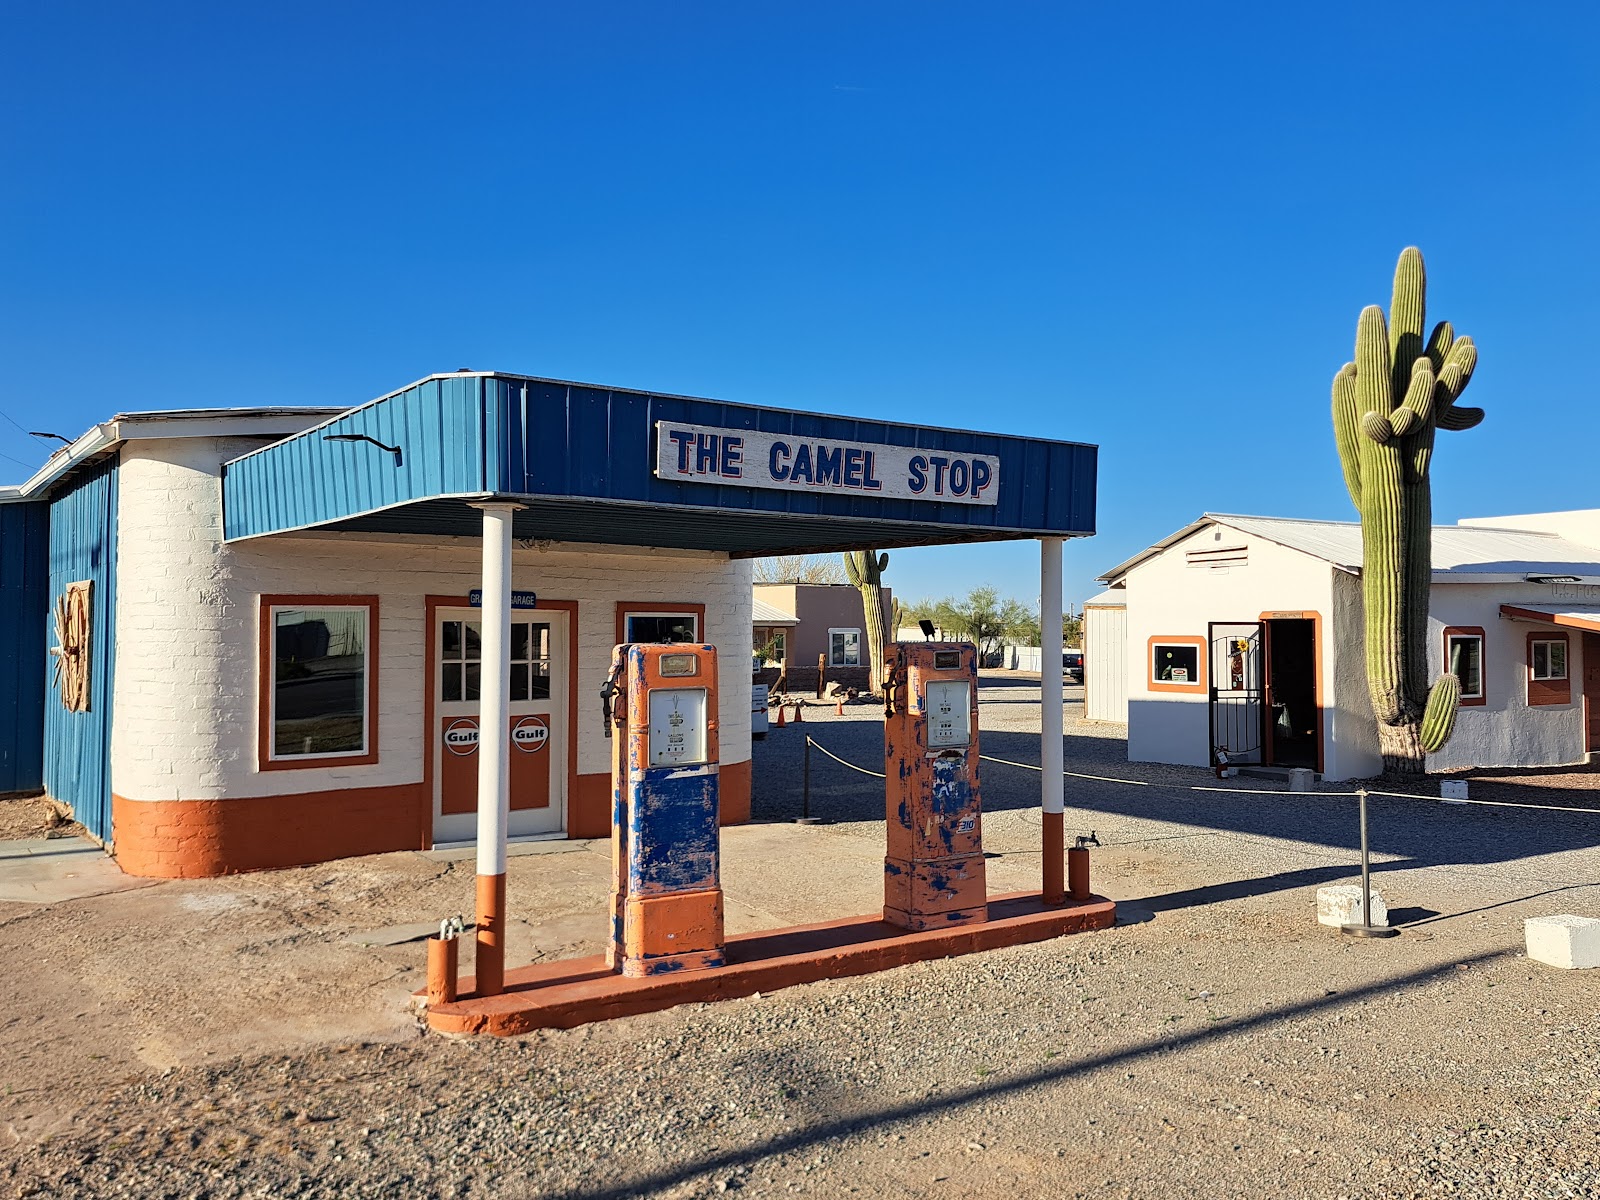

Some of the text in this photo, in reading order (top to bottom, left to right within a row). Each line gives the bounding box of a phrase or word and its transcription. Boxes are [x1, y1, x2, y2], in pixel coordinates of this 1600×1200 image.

[670, 430, 992, 498] THE CAMEL STOP
[447, 732, 479, 742] Gulf
[515, 729, 545, 739] Gulf
